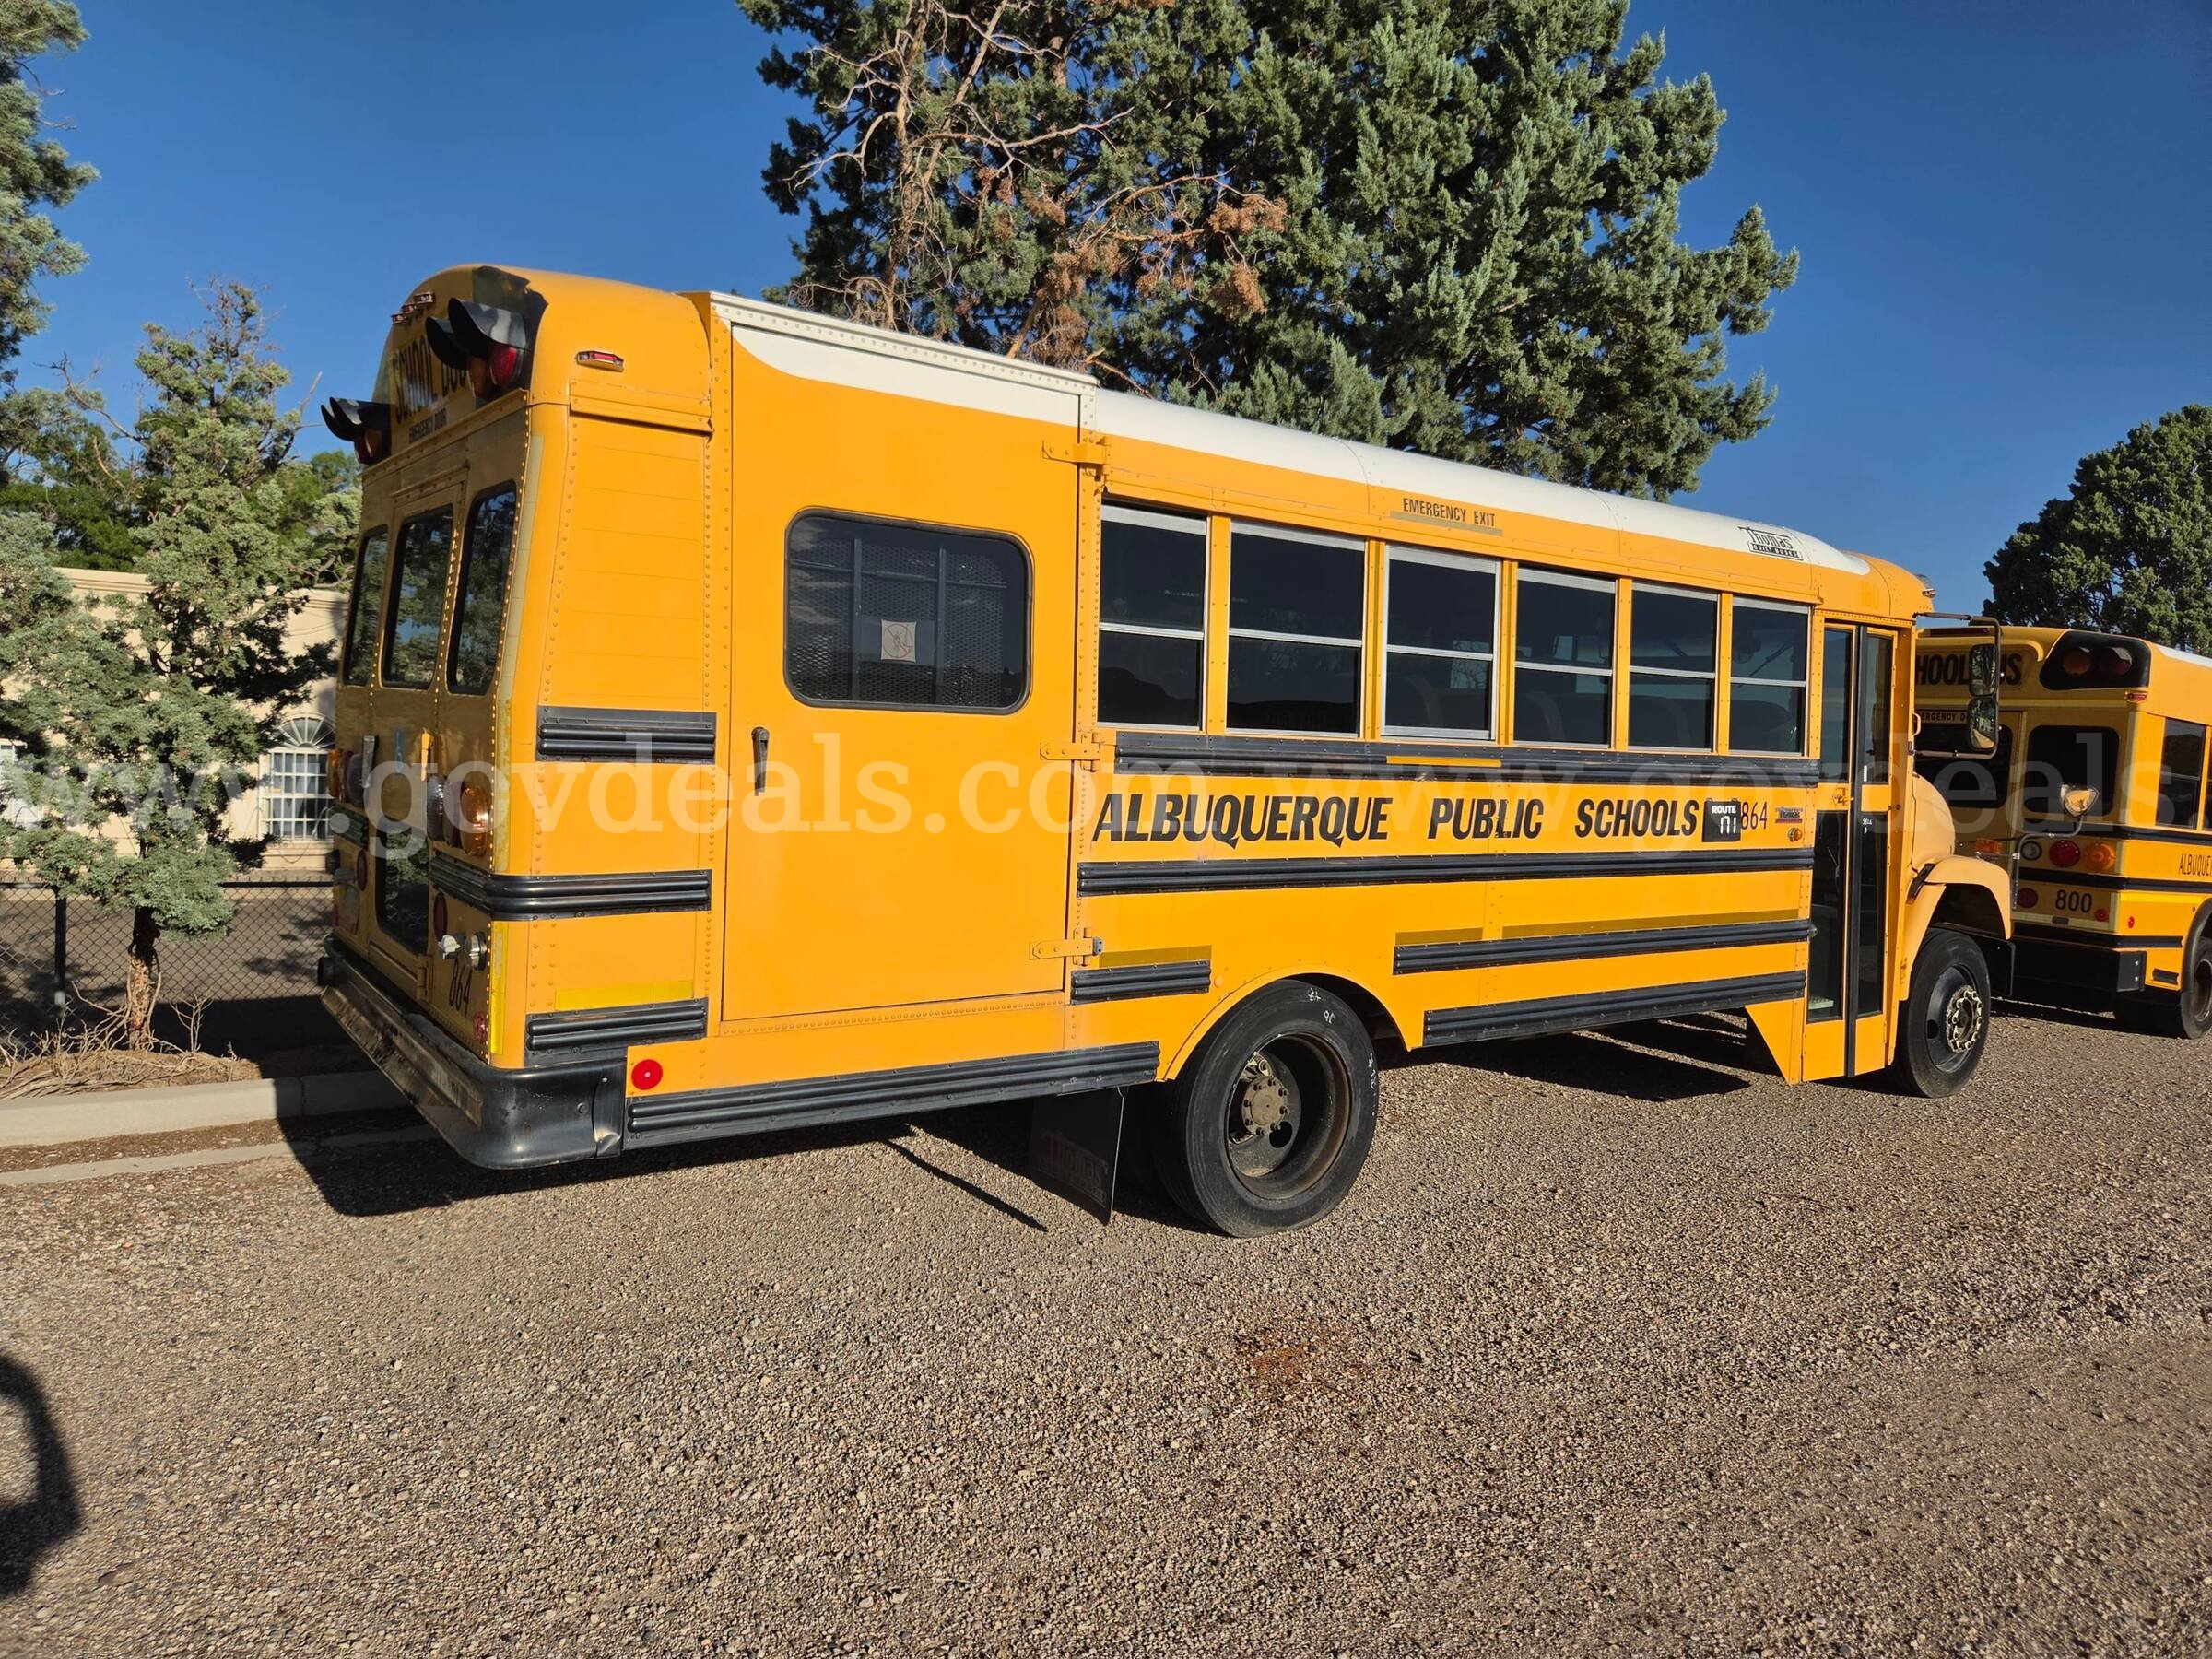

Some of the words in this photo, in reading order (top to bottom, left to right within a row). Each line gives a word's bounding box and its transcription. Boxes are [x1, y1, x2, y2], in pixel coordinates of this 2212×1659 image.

[1403, 498, 1466, 522] EMERGENCY
[1473, 511, 1496, 526] EXIT
[1737, 526, 1794, 549] Thomas
[1092, 793, 1394, 850] ALBUQUERQUE
[1426, 797, 1545, 840] PUBLIC
[1574, 798, 1700, 839] SCHOOLS
[1712, 805, 1736, 814] ROUTE
[1741, 801, 1768, 830] 864
[1720, 816, 1736, 834] 171
[2055, 889, 2092, 913] 800
[449, 957, 473, 1018] 864
